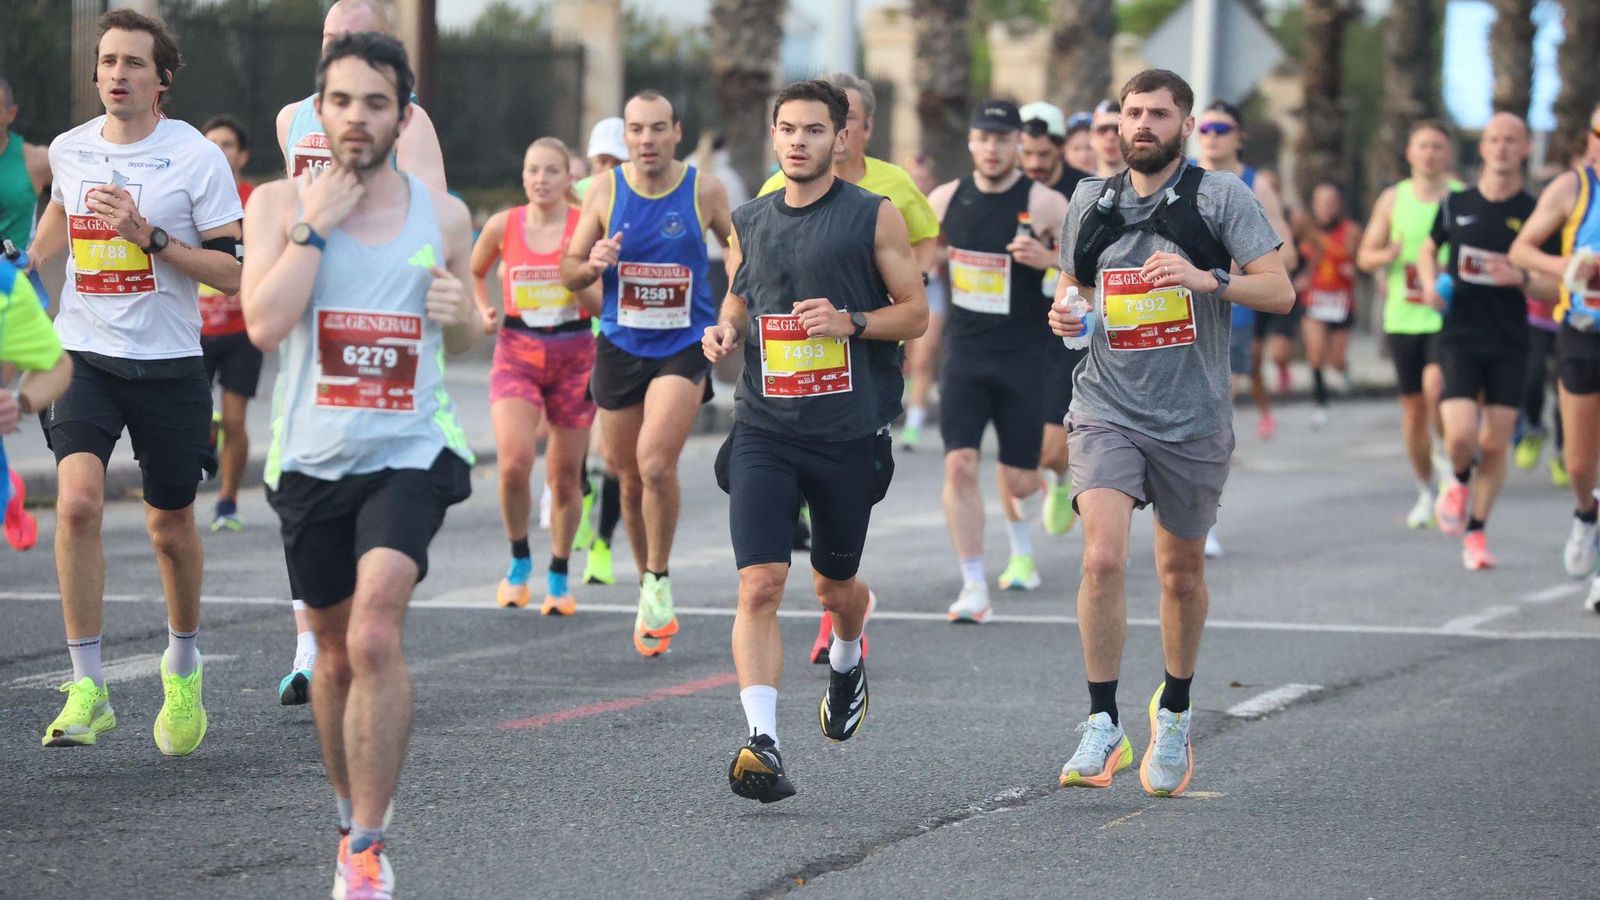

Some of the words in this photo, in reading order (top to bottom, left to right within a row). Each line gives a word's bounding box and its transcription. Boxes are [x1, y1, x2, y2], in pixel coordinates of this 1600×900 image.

[88, 244, 127, 259] 7788
[638, 265, 686, 278] GENERALI
[633, 286, 675, 300] 12581
[1123, 296, 1167, 313] 7492
[346, 314, 417, 334] GENERALI
[343, 344, 398, 368] 6279
[783, 343, 825, 359] 7493
